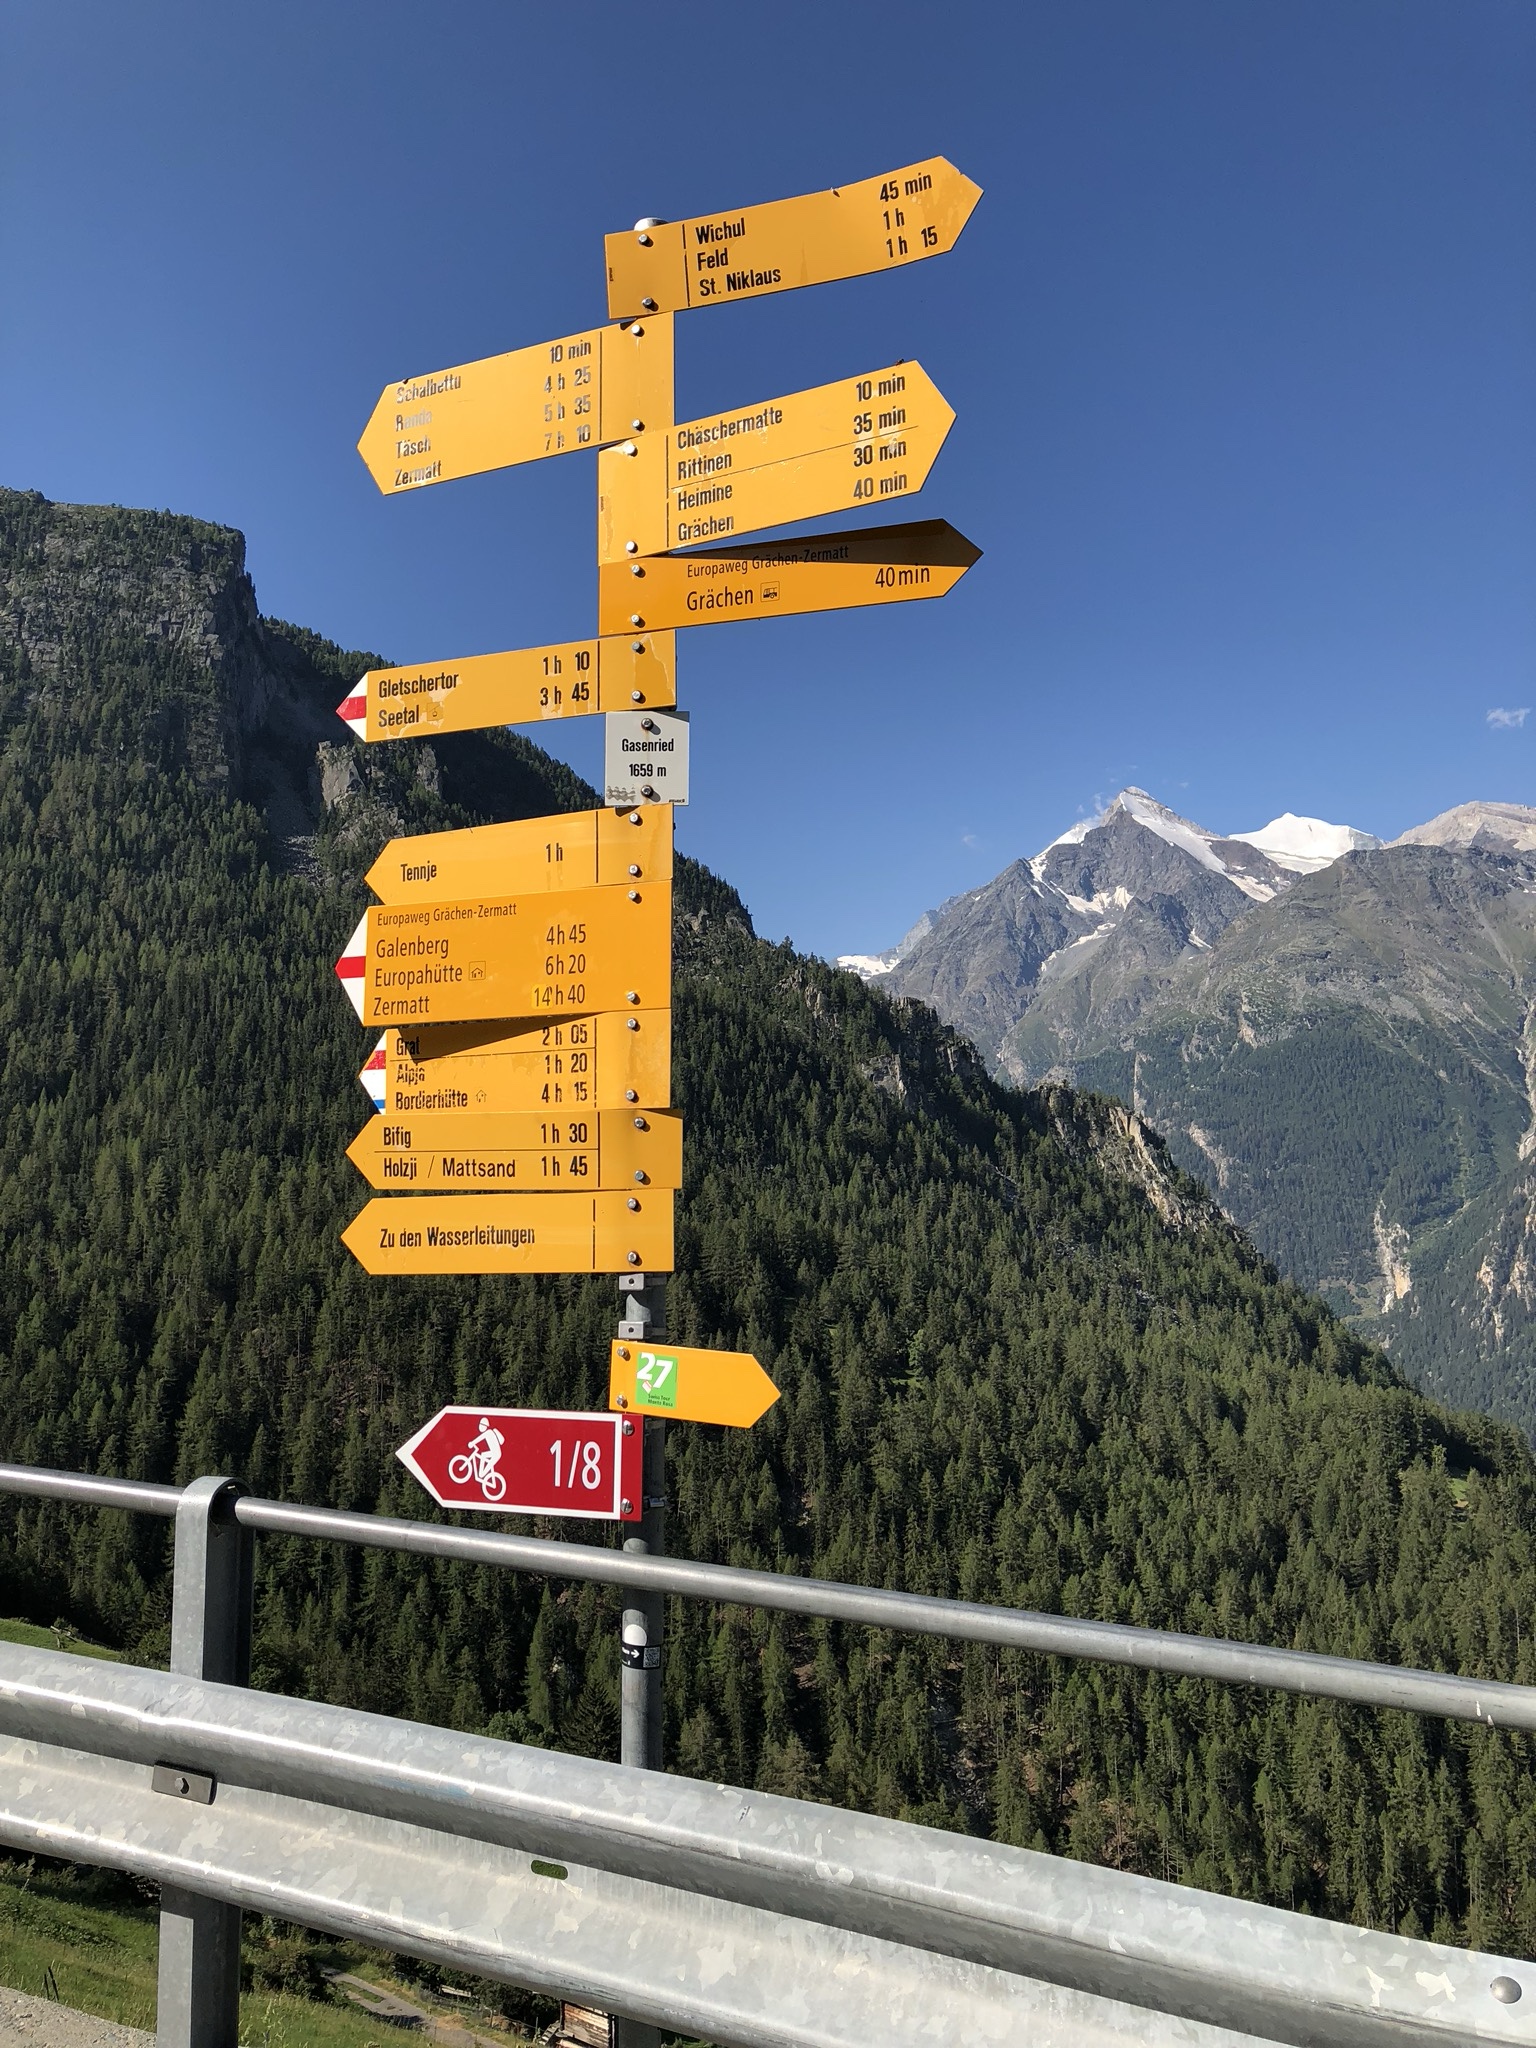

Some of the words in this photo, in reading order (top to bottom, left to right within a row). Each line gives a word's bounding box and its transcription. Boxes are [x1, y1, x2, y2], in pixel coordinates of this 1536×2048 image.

[696, 218, 745, 244] Wichul
[880, 184, 899, 202] 45
[905, 172, 932, 196] min
[697, 248, 728, 271] Feld
[883, 212, 890, 230] 1
[896, 208, 904, 227] h
[699, 279, 721, 297] St.
[727, 268, 781, 292] Niklaus
[886, 239, 893, 257] 1
[898, 235, 907, 255] h
[921, 227, 938, 248] 15
[397, 374, 461, 404] Schalbettu
[550, 345, 563, 364] 10
[568, 340, 591, 360] min
[544, 376, 552, 393] 4
[558, 374, 565, 390] h
[574, 366, 591, 385] 25
[396, 434, 431, 458] Täsch
[544, 404, 552, 422] 5
[558, 403, 565, 420] h
[574, 394, 591, 414] 35
[678, 407, 782, 449] Chäschermatte
[856, 381, 872, 402] 10
[878, 373, 905, 397] min
[395, 460, 441, 486] Zermatt
[544, 432, 552, 451] 7
[557, 431, 564, 448] h
[576, 424, 590, 443] 10
[678, 452, 732, 481] Rittinen
[853, 413, 872, 435] 35
[879, 406, 906, 430] min
[678, 483, 732, 511] Heimine
[853, 446, 873, 467] 30
[879, 438, 907, 462] min
[678, 514, 734, 541] Grächen
[853, 478, 873, 499] 40
[880, 471, 907, 494] min
[687, 554, 747, 578] Europaweg
[752, 546, 849, 569] Grächen-Zermatt
[687, 586, 753, 611] Grächen
[378, 672, 459, 699] Gletschertor
[543, 657, 549, 676] 1
[554, 655, 561, 674] h
[575, 651, 590, 671] 10
[378, 706, 419, 728] Seetal
[540, 687, 548, 706] 3
[554, 686, 562, 705] h
[571, 682, 590, 701] 45
[622, 738, 674, 752] Gasenried
[629, 763, 654, 778] 1659
[656, 766, 667, 778] m
[401, 860, 437, 882] Tennje
[546, 844, 551, 862] 1
[556, 843, 563, 861] h
[377, 910, 430, 928] Europaweg
[433, 903, 517, 923] Grächen-Zermatt
[376, 936, 449, 959] Galenberg
[375, 963, 462, 990] Europahütte
[374, 994, 429, 1016] Zermatt
[397, 1036, 419, 1055] Grat
[542, 1027, 549, 1046] 2
[555, 1026, 562, 1044] h
[571, 1024, 587, 1044] 05
[545, 1055, 550, 1074] 1
[555, 1054, 562, 1073] h
[571, 1053, 587, 1073] 20
[541, 1085, 549, 1103] 4
[555, 1083, 562, 1101] h
[574, 1082, 587, 1101] 15
[383, 1127, 411, 1148] Bifig
[541, 1125, 547, 1143] 1
[552, 1124, 559, 1142] h
[569, 1123, 587, 1143] 30
[383, 1157, 417, 1179] Holzji
[442, 1157, 515, 1178] Mattsand
[541, 1158, 547, 1176] 1
[552, 1157, 559, 1175] h
[569, 1156, 587, 1175] 45
[380, 1229, 395, 1248] Zu
[400, 1226, 421, 1247] den
[427, 1226, 535, 1249] Wasserleitungen
[637, 1352, 673, 1388] 27
[550, 1440, 601, 1490] 1/8
